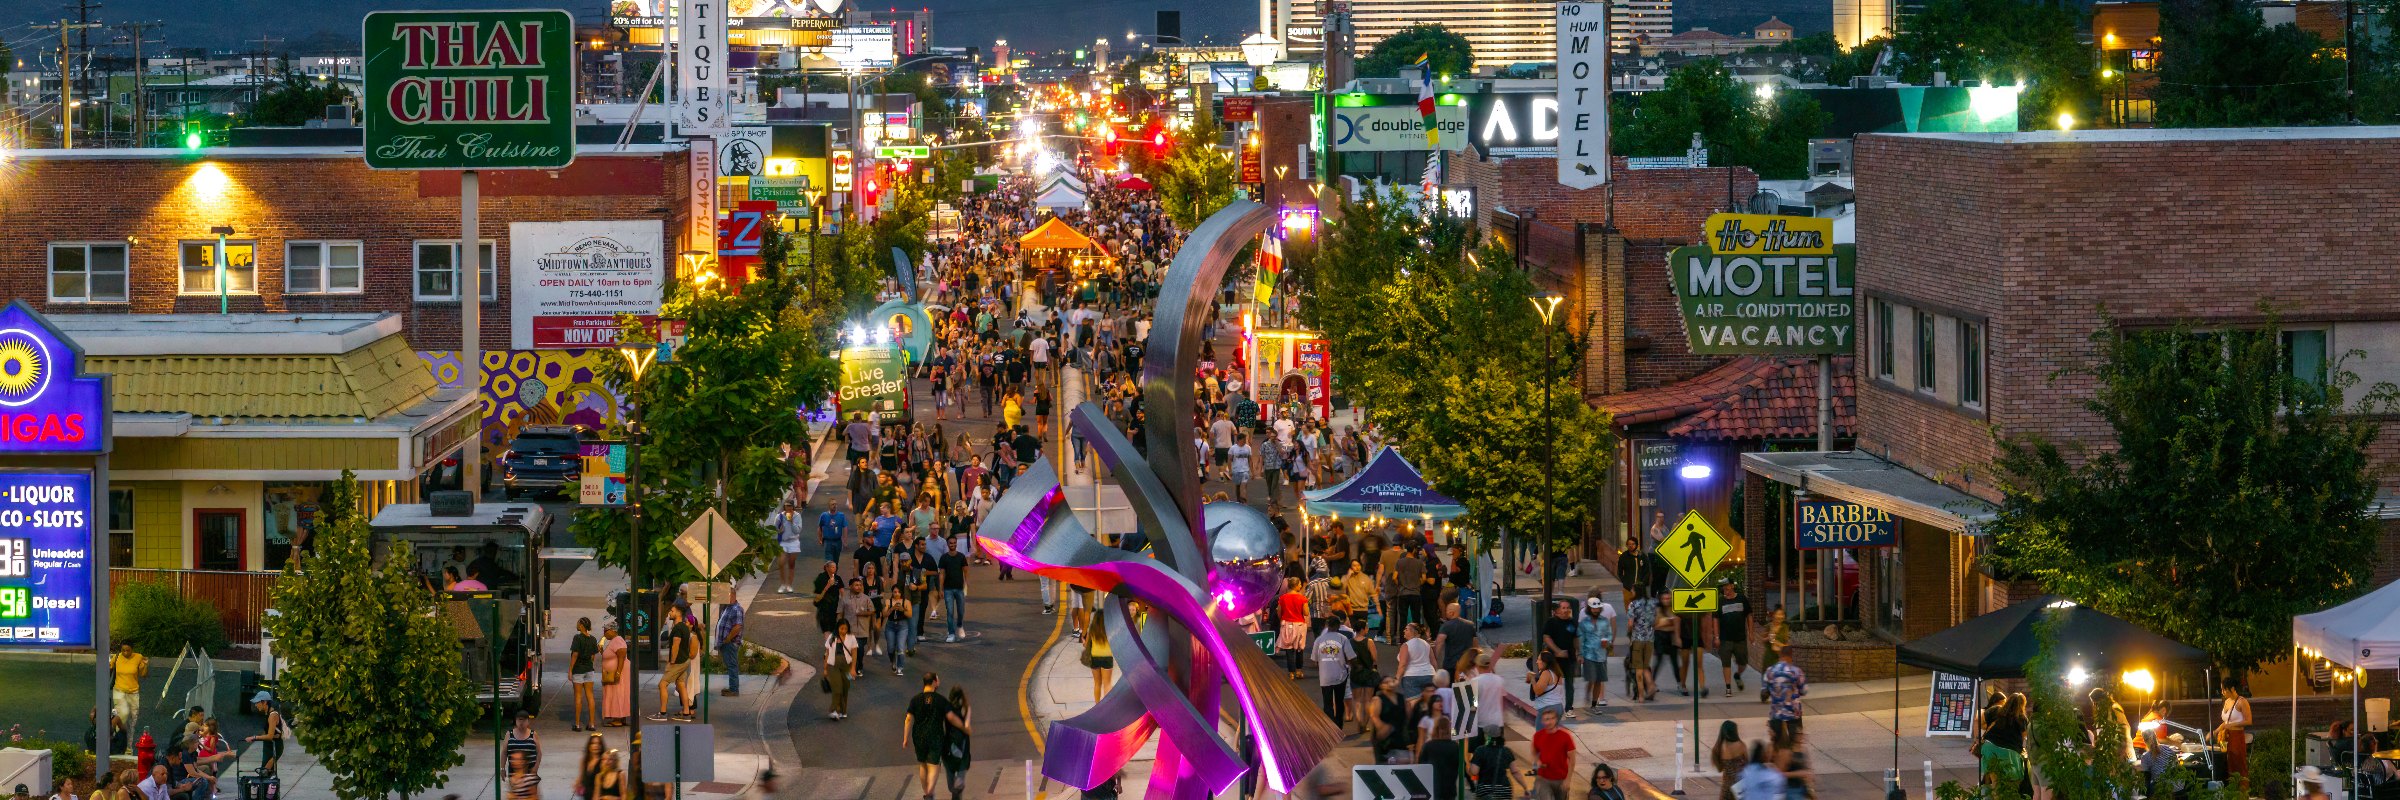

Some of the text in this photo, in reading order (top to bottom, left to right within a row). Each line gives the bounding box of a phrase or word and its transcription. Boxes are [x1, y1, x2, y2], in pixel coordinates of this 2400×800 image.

[1562, 5, 1581, 16] HO
[613, 17, 629, 25] 20%
[630, 16, 640, 25] off
[642, 16, 652, 25] for
[791, 18, 840, 29] PEPPERMILL
[1570, 22, 1598, 32] HUM
[1287, 27, 1311, 36] SOUTH
[392, 21, 545, 70] THAI
[387, 76, 551, 125] CHILI
[1571, 36, 1591, 157] MOTEL
[1371, 119, 1465, 133] double dge
[731, 130, 746, 138] SPY
[376, 133, 561, 159] Thai Cuisine
[696, 151, 710, 237] 775-440-1151
[575, 239, 618, 253] RENO NEVADA
[537, 257, 652, 271] MIDTOWN ANTIQUES
[540, 279, 565, 287] OPEN
[568, 279, 594, 287] DAILY
[633, 278, 653, 288] 6pm
[1687, 256, 1854, 297] MOTEL
[569, 290, 624, 298] 775-440-1151
[1695, 302, 1851, 318] AIR CONDITIONED
[573, 319, 585, 327] Free
[585, 319, 605, 327] Parking
[564, 328, 628, 343] NOW OPE
[1698, 325, 1850, 346] VACANCY
[846, 364, 884, 385] Live
[839, 378, 903, 401] Greater
[10, 485, 75, 505] LIQUOR
[1361, 503, 1425, 514] RENO NEVADA
[1801, 504, 1892, 524] BARBER
[0, 510, 84, 528] CO SLOTS
[1814, 523, 1878, 543] SHOP
[33, 548, 84, 559] Unleaded
[33, 559, 63, 569] Regular
[33, 596, 80, 609] Diesel
[1938, 681, 1971, 690] FAMILY ZONE
